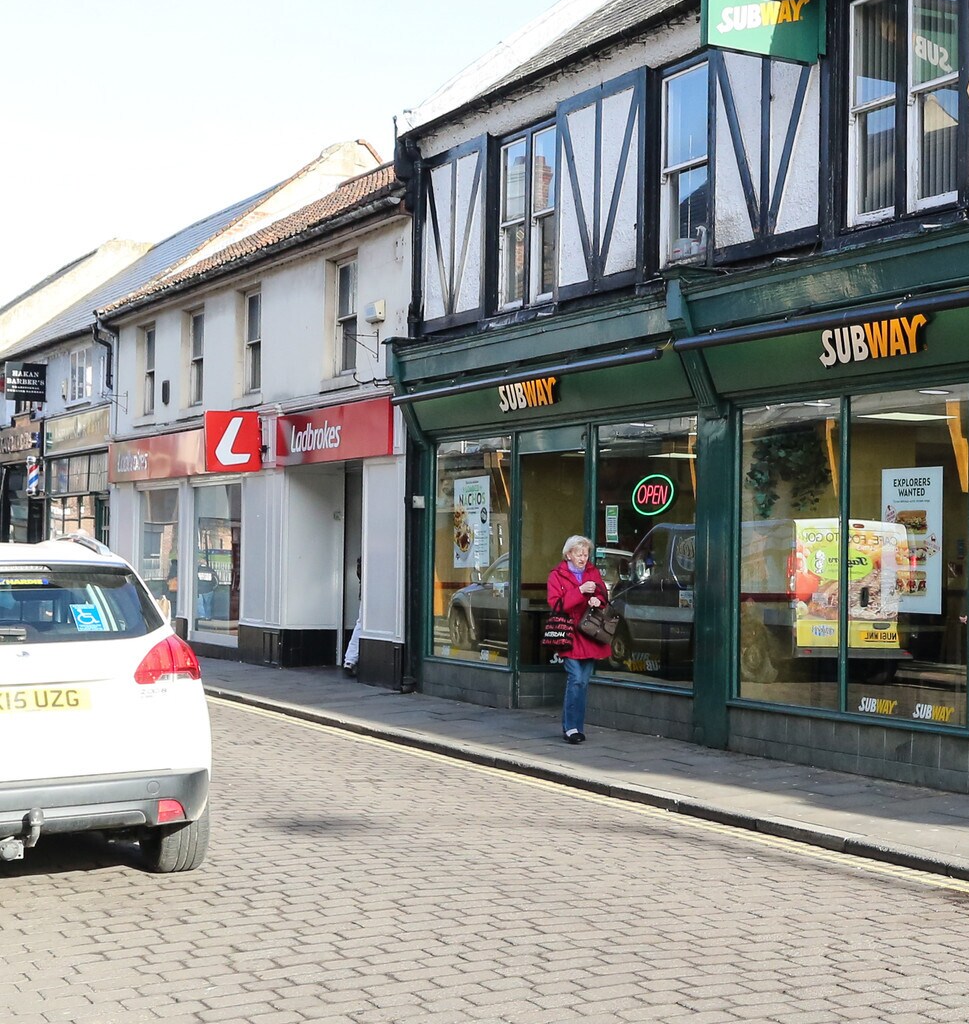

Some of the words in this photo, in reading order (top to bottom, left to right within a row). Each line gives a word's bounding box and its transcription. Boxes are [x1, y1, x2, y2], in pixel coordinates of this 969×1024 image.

[819, 313, 927, 368] SUBWAY
[6, 377, 45, 386] BARBER'S
[12, 370, 39, 378] HAKAN
[498, 376, 557, 413] SUBWAY
[290, 420, 342, 453] Ladbrokes
[893, 477, 931, 488] EXPLORERS
[459, 492, 486, 506] NACHOS
[637, 484, 669, 505] OPEN
[898, 487, 926, 497] WANTED
[34, 689, 80, 708] UZG
[858, 696, 897, 714] SUBWAY
[913, 703, 954, 722] SUBWAY
